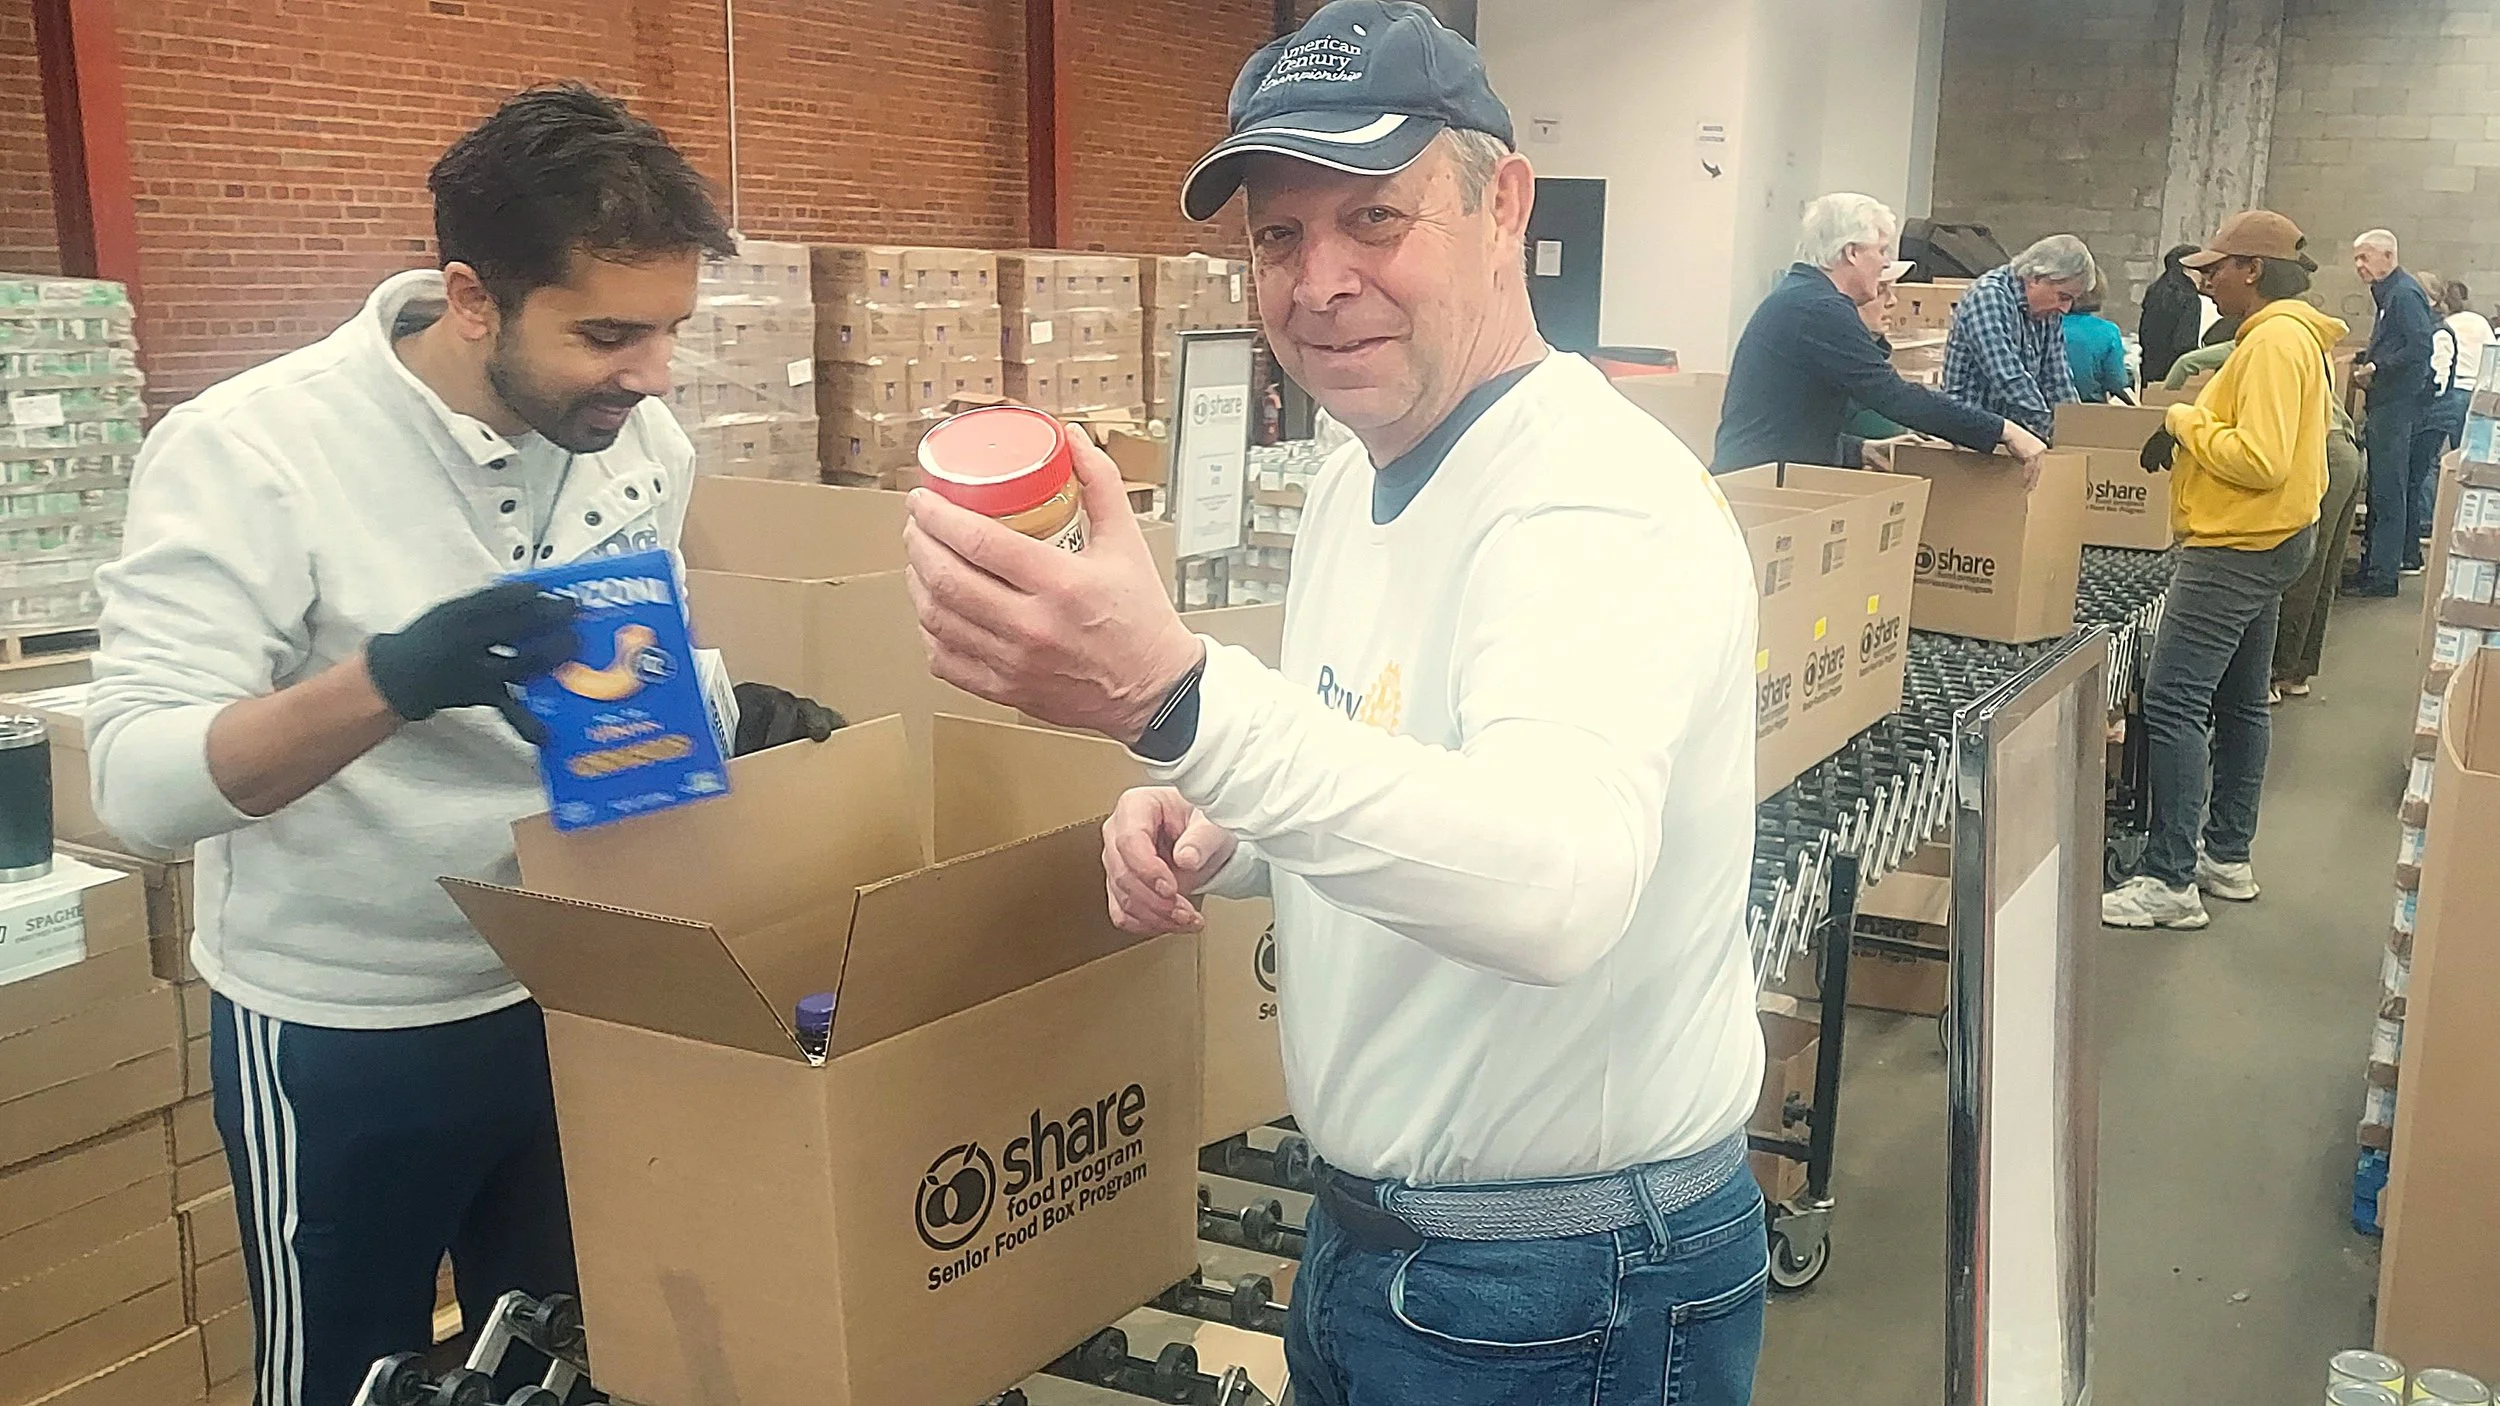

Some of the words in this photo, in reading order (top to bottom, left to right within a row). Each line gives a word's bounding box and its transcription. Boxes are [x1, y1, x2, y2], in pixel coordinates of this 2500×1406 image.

[1281, 34, 1362, 60] American
[1277, 53, 1352, 75] Century
[1209, 395, 1242, 416] share
[2095, 479, 2147, 501] share
[1938, 547, 1995, 576] share
[1873, 616, 1900, 648] share
[1817, 644, 1845, 681] share
[1760, 672, 1792, 712] share
[1003, 1083, 1146, 1196] share
[1007, 1177, 1055, 1222] food
[1060, 1138, 1143, 1203] program
[928, 1246, 990, 1290] Senior
[995, 1218, 1038, 1257] Food
[1043, 1201, 1075, 1232] Box
[1079, 1162, 1147, 1211] Program
